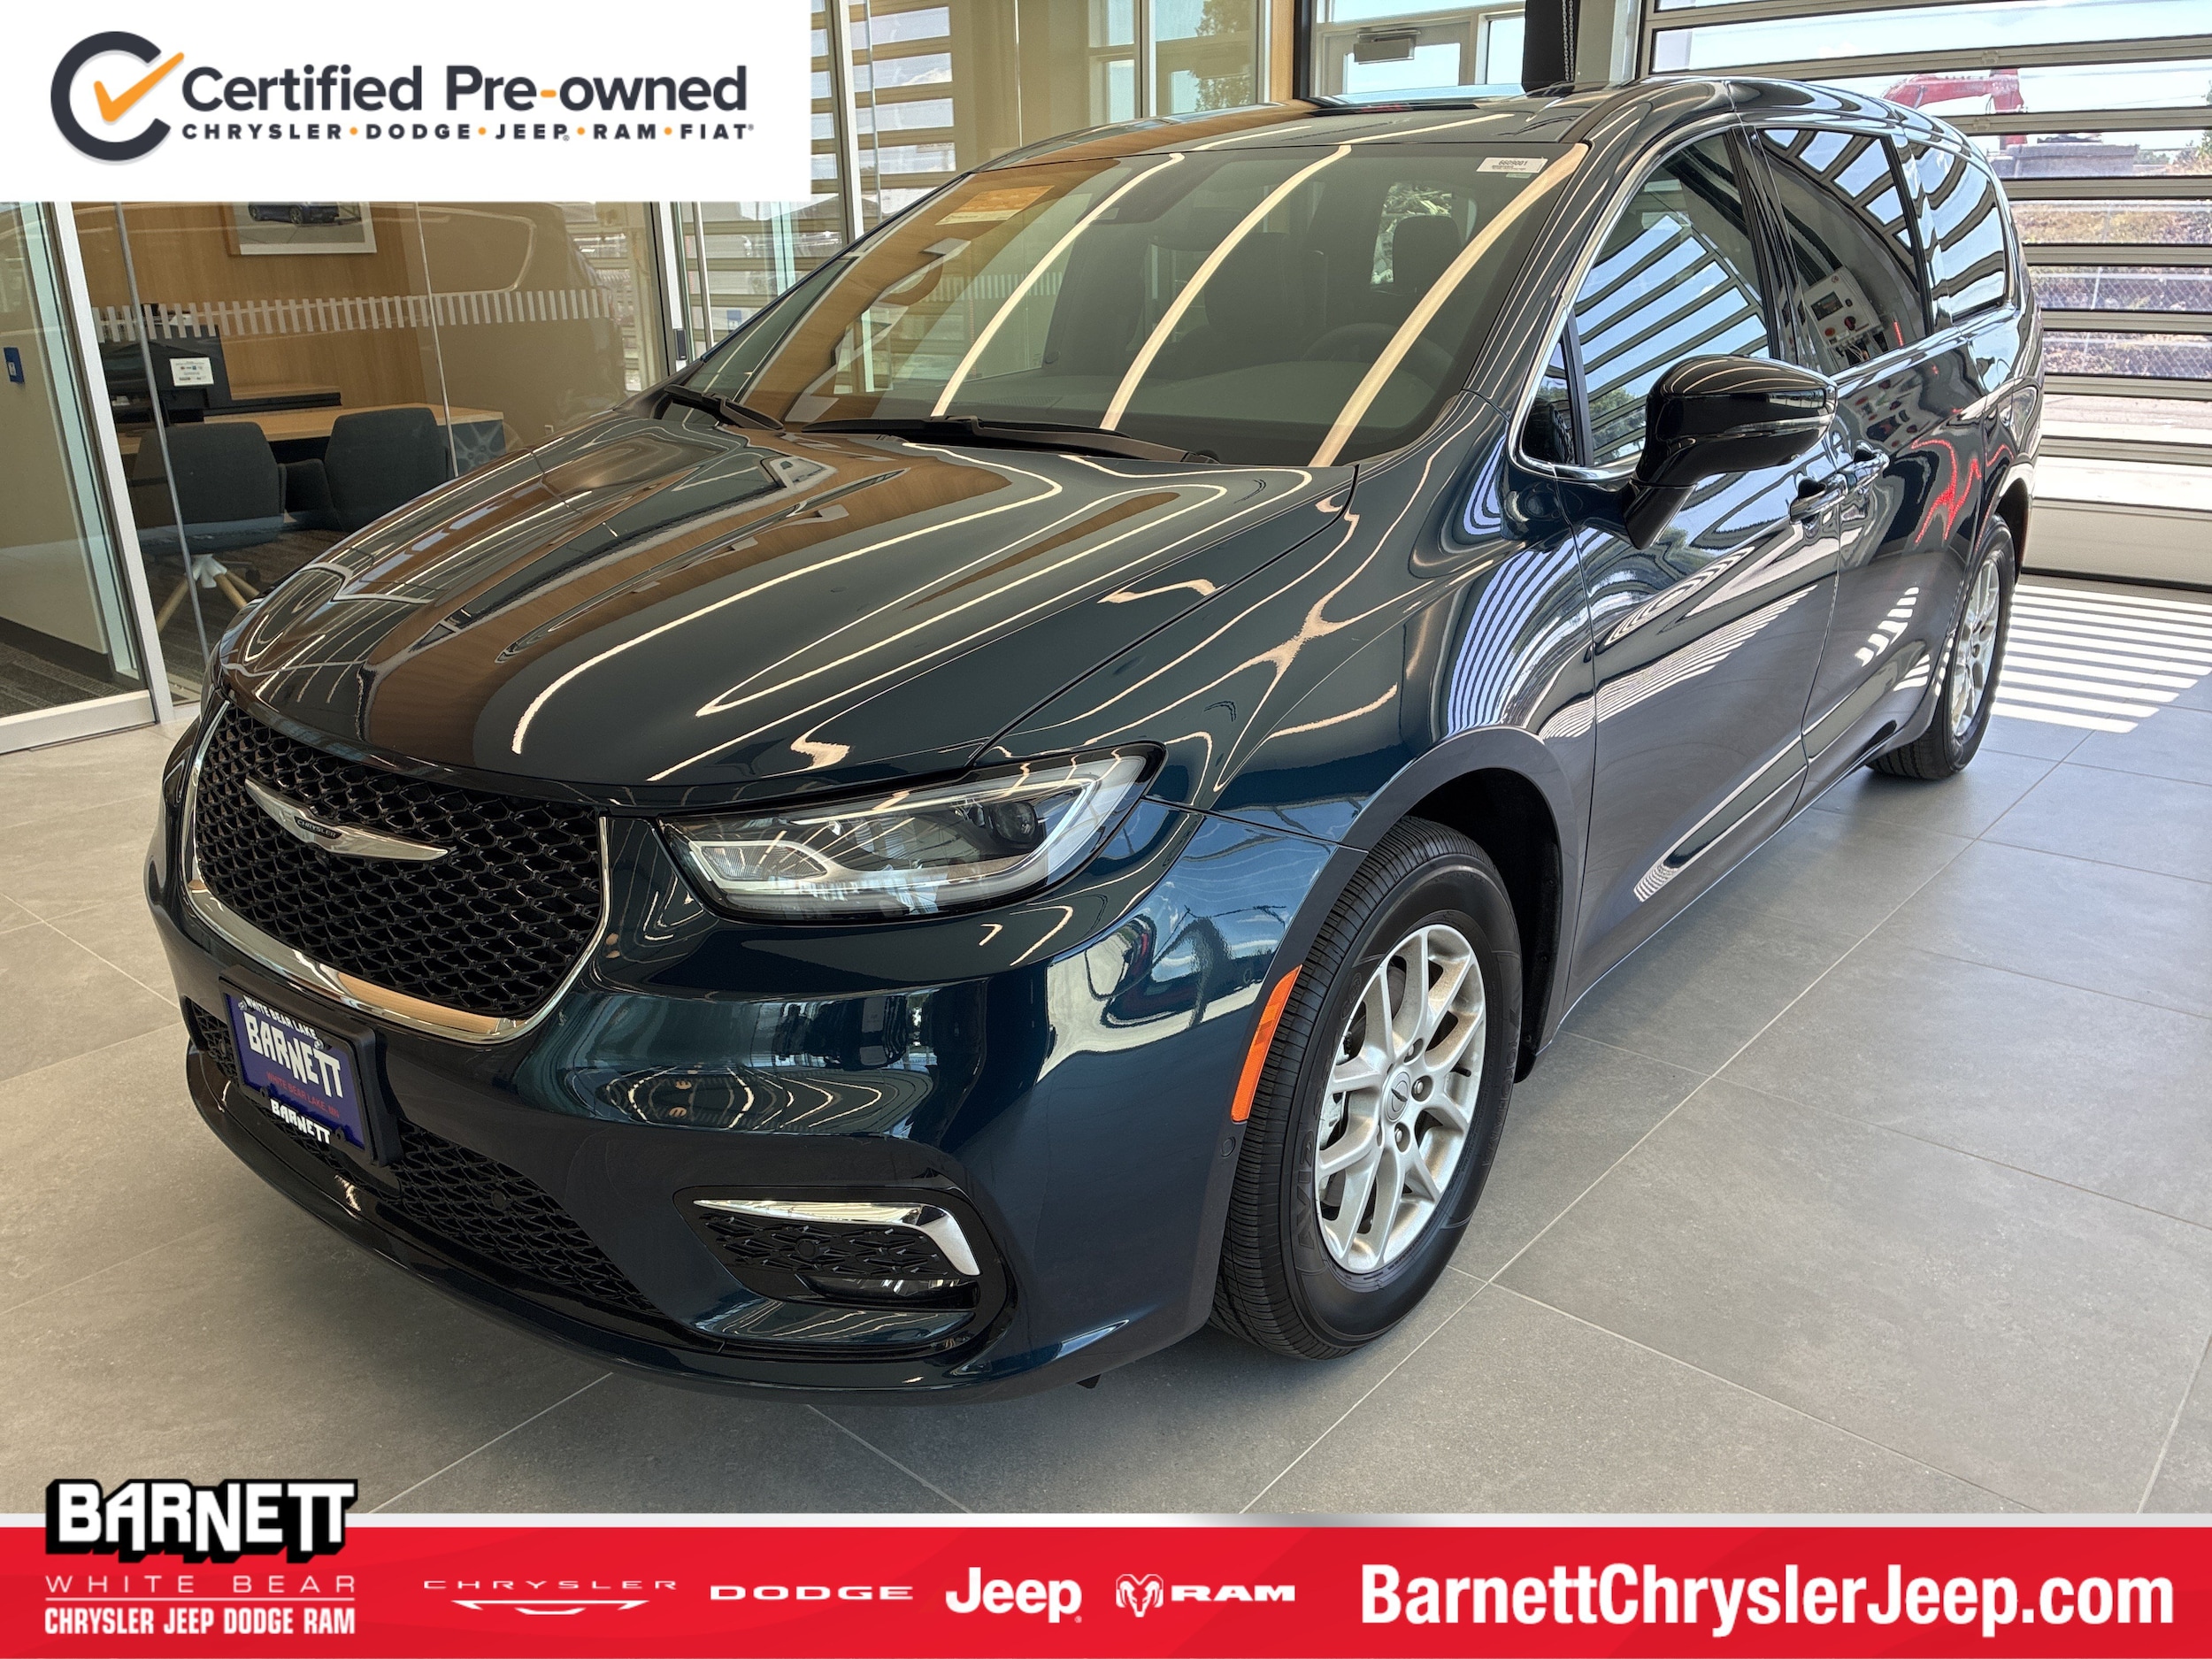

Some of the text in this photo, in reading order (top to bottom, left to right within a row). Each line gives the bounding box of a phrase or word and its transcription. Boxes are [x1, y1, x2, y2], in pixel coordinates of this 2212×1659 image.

[296, 818, 337, 838] CHRYSLER
[242, 995, 319, 1041] WHITE BEAR LAKE
[243, 1011, 344, 1099] BARNETT
[266, 1071, 288, 1090] WHITE
[288, 1083, 307, 1101] BEAR
[270, 1098, 332, 1144] BARNETT
